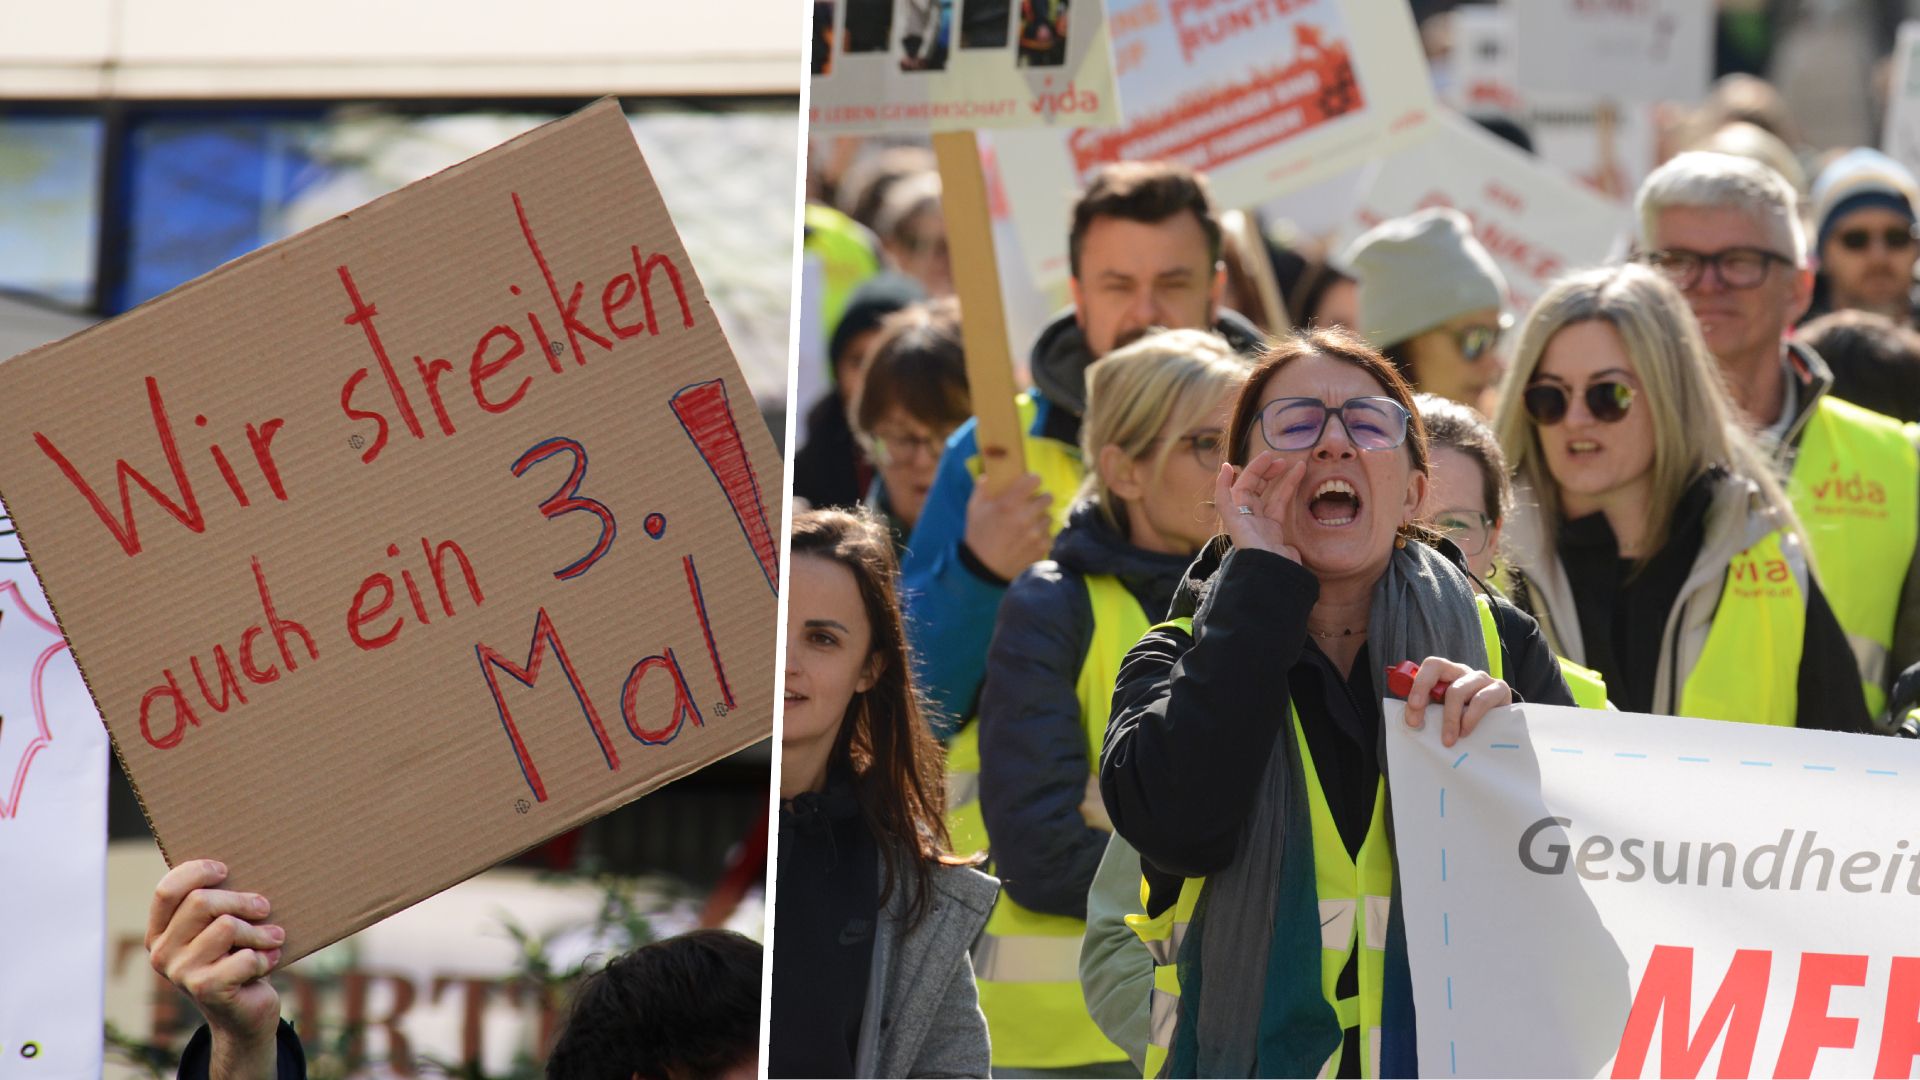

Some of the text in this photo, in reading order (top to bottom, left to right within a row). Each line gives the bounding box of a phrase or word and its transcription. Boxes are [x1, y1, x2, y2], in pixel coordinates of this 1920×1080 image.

[1029, 74, 1101, 115] vida
[33, 193, 697, 558] Wir streiken
[1811, 457, 1888, 504] vida
[139, 436, 668, 752] auch ein 3.
